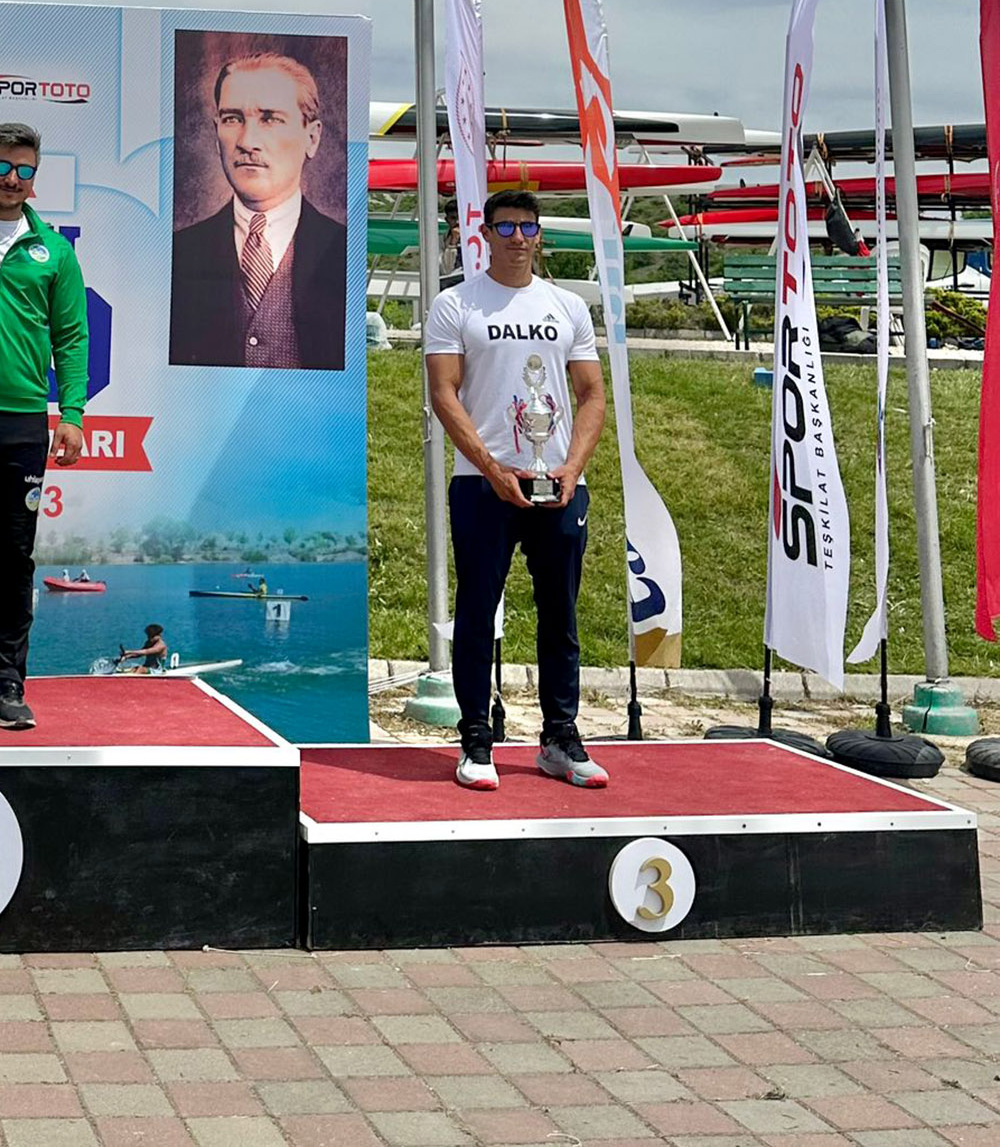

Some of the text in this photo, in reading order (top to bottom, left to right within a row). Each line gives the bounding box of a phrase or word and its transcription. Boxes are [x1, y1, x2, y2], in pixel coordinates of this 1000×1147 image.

[487, 324, 558, 342] DALKO
[272, 603, 281, 617] 1
[637, 855, 674, 920] 3
